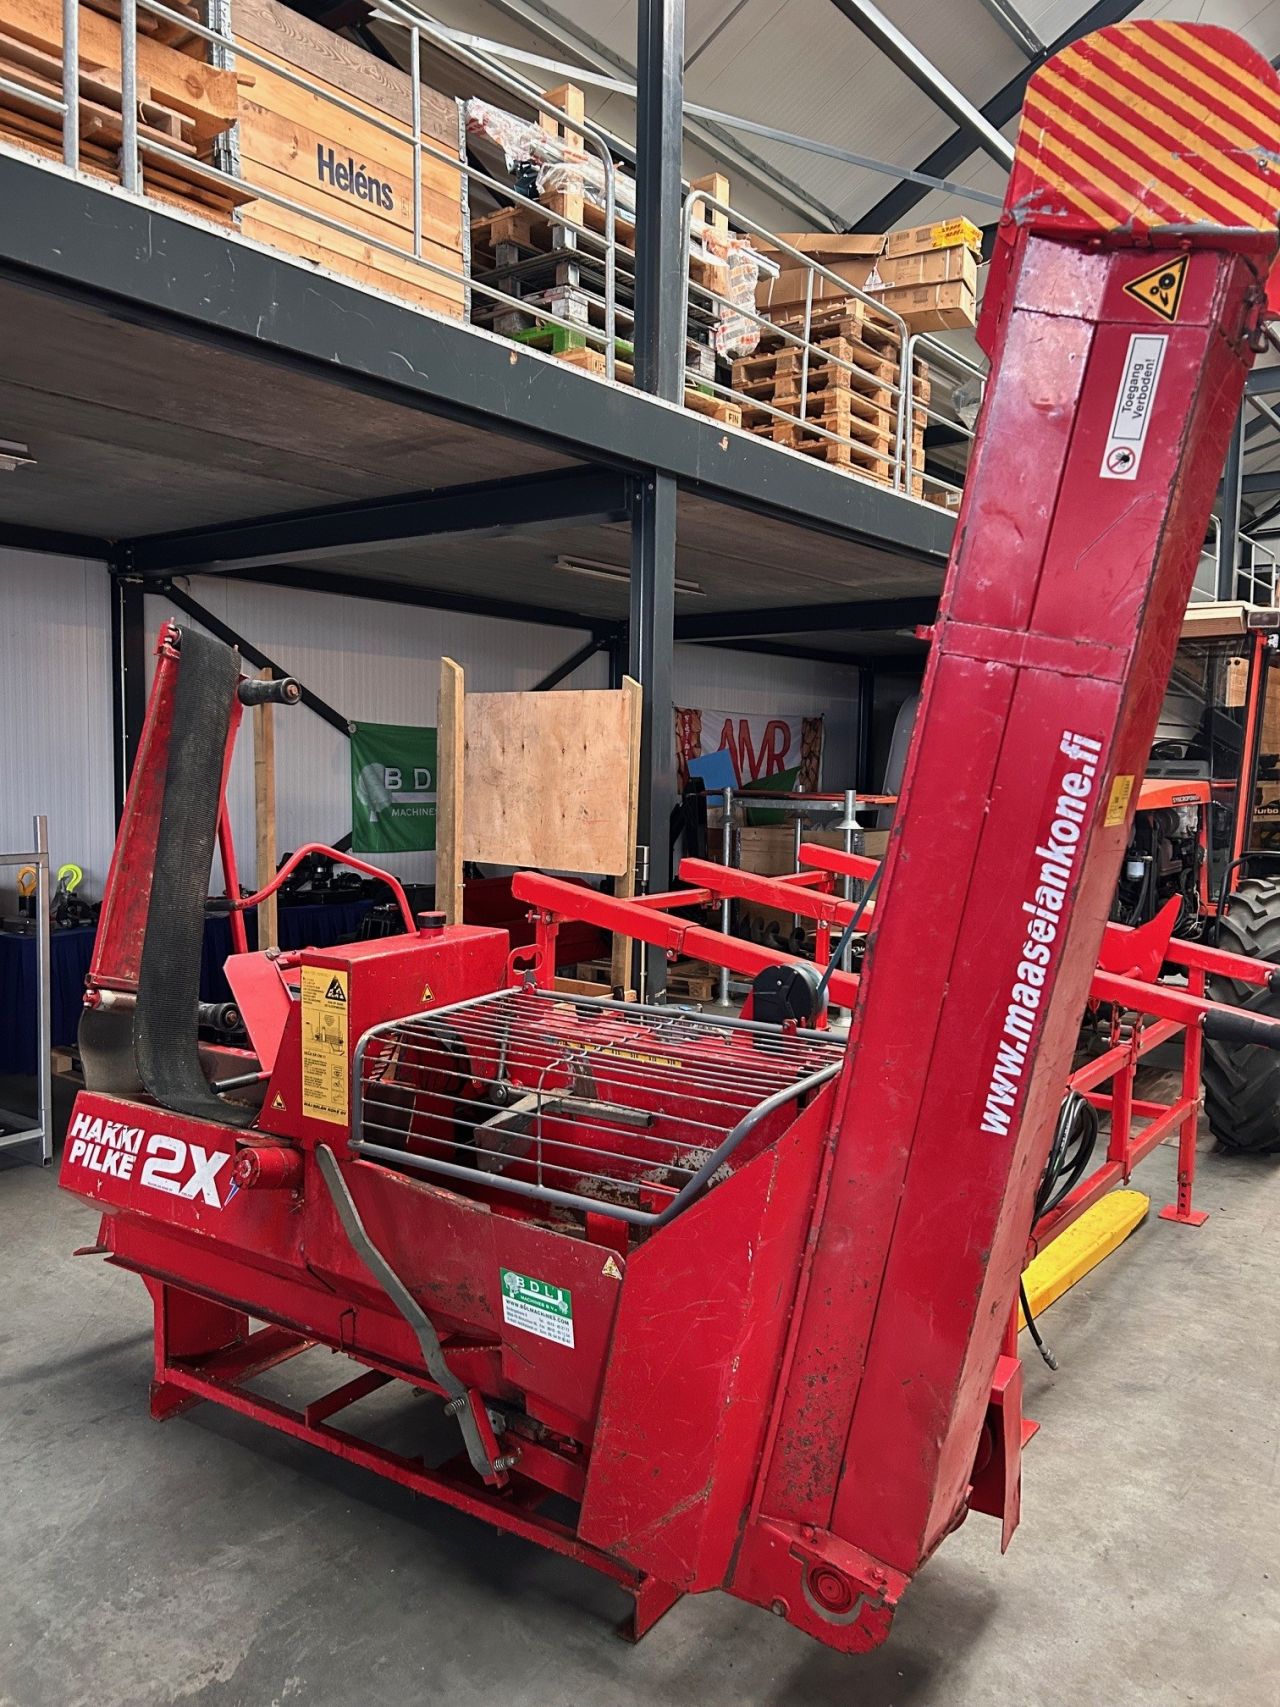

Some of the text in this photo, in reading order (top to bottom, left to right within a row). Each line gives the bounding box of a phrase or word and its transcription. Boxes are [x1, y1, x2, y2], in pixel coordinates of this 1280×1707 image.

[317, 143, 394, 211] Heléns
[1122, 363, 1144, 413] Toegang
[1132, 359, 1155, 419] Verboden!
[980, 731, 1103, 1137] www.maaselankone.fi
[68, 1139, 137, 1181] PILKE
[70, 1112, 145, 1155] HAKKI
[140, 1134, 231, 1209] 2X
